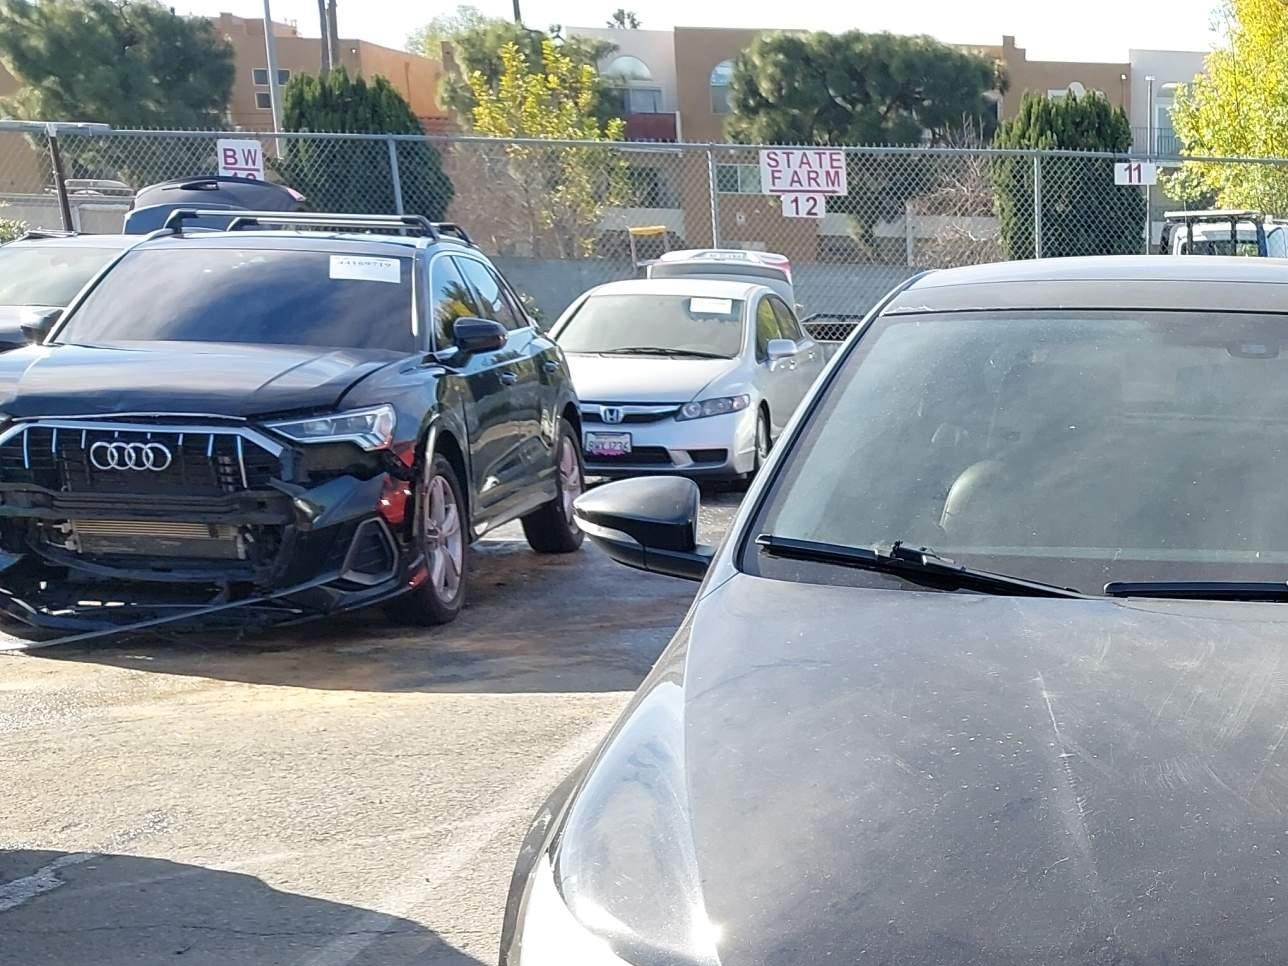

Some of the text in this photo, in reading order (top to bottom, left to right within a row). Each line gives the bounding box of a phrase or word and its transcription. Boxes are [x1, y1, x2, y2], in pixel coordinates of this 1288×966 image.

[223, 147, 258, 167] BW
[766, 151, 843, 170] STATE
[770, 169, 841, 188] FARM
[1124, 163, 1142, 184] 11
[790, 196, 819, 216] 12
